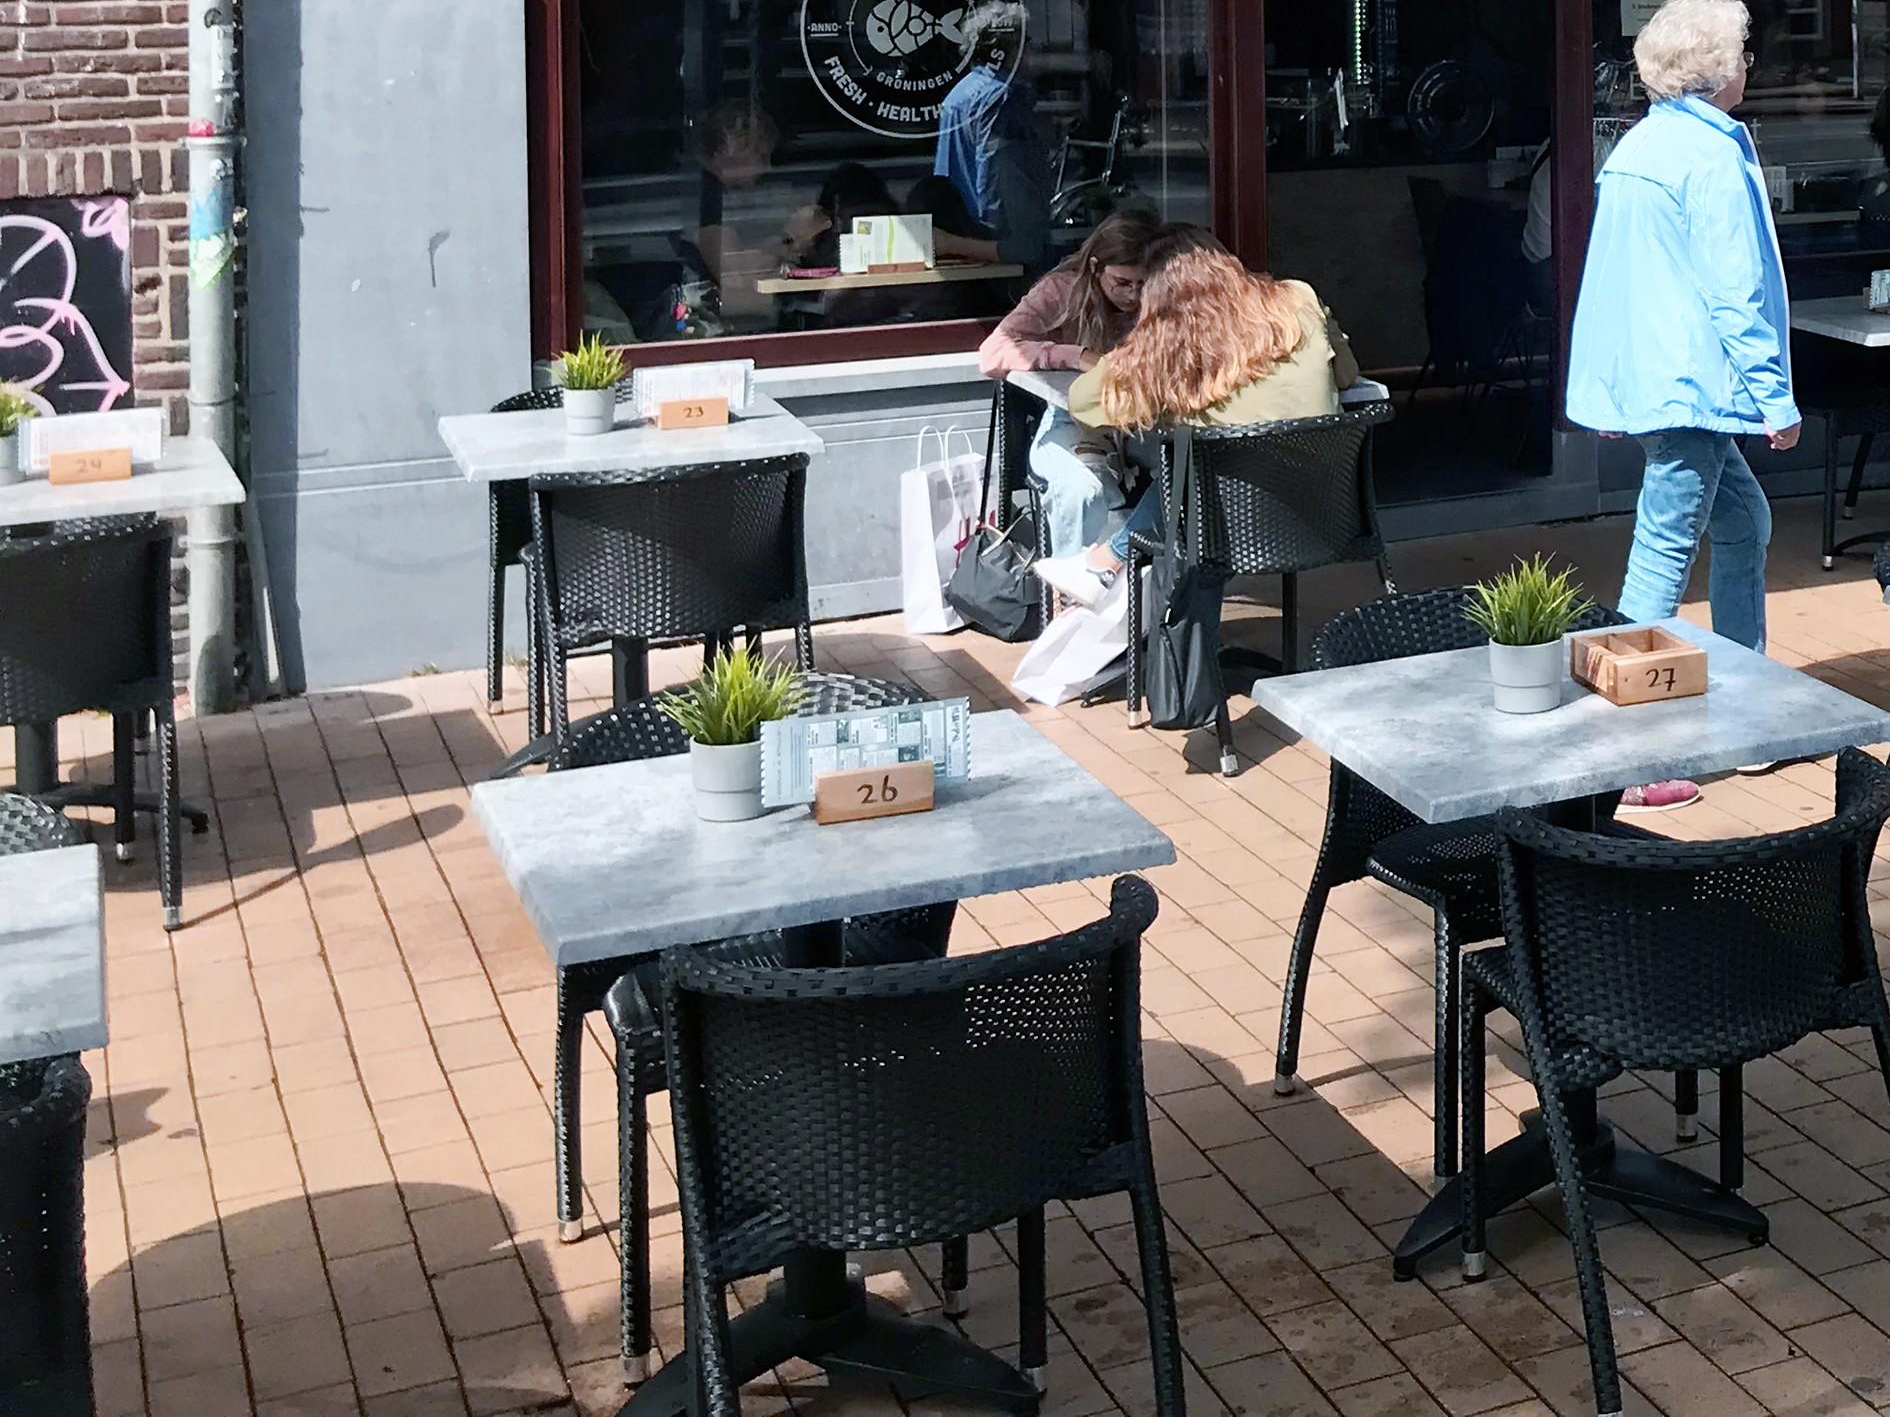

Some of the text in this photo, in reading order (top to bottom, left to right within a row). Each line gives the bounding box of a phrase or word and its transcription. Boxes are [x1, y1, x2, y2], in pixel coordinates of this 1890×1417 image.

[824, 55, 945, 123] FRESH HEALTH
[875, 70, 954, 92] GRONINGEN
[683, 405, 704, 419] 23
[75, 458, 102, 474] 24
[1644, 666, 1677, 693] 27
[856, 774, 899, 805] 26
